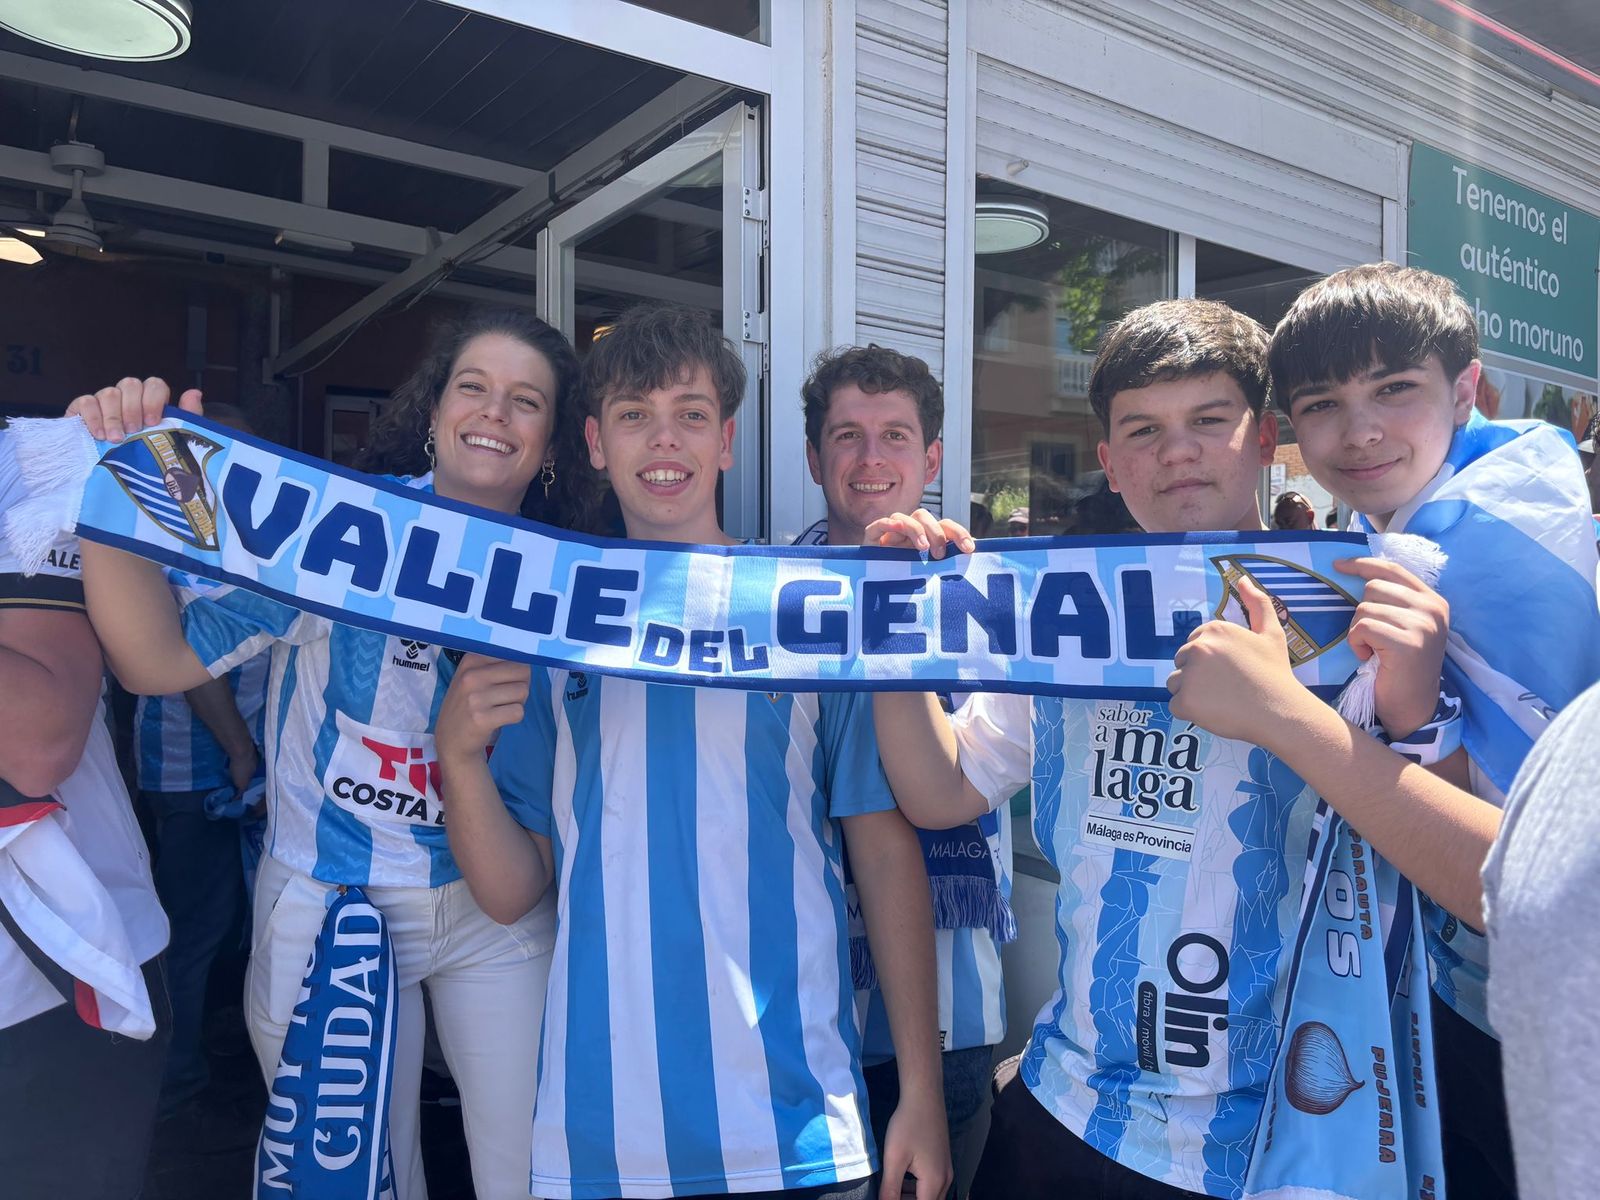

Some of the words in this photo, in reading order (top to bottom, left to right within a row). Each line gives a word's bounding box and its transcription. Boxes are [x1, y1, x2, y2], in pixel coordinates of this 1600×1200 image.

[1452, 164, 1547, 237] Tenemos
[1551, 211, 1568, 245] el
[1460, 242, 1560, 299] auténtico
[1509, 317, 1584, 363] moruno
[166, 480, 181, 498] DEL
[44, 549, 82, 570] ALE
[221, 462, 640, 648] VALLE
[637, 622, 769, 673] DEL
[775, 569, 1203, 660] GENAL
[392, 653, 431, 673] hummel
[1097, 703, 1151, 725] sabor
[1095, 725, 1108, 743] a
[1109, 721, 1203, 772] má
[332, 776, 428, 822] COSTA
[1091, 749, 1198, 819] laga
[1085, 821, 1122, 842] Málaga
[1123, 831, 1134, 843] es
[1135, 830, 1192, 854] Provincia
[1347, 828, 1373, 941] PARAUTA
[1142, 990, 1154, 1018] fibra
[1164, 932, 1230, 1068] Olin
[312, 903, 383, 1171] CIUDAD
[1141, 1028, 1154, 1057] móvil
[261, 1062, 303, 1194] MUY
[1370, 1045, 1396, 1164] PUJERRA
